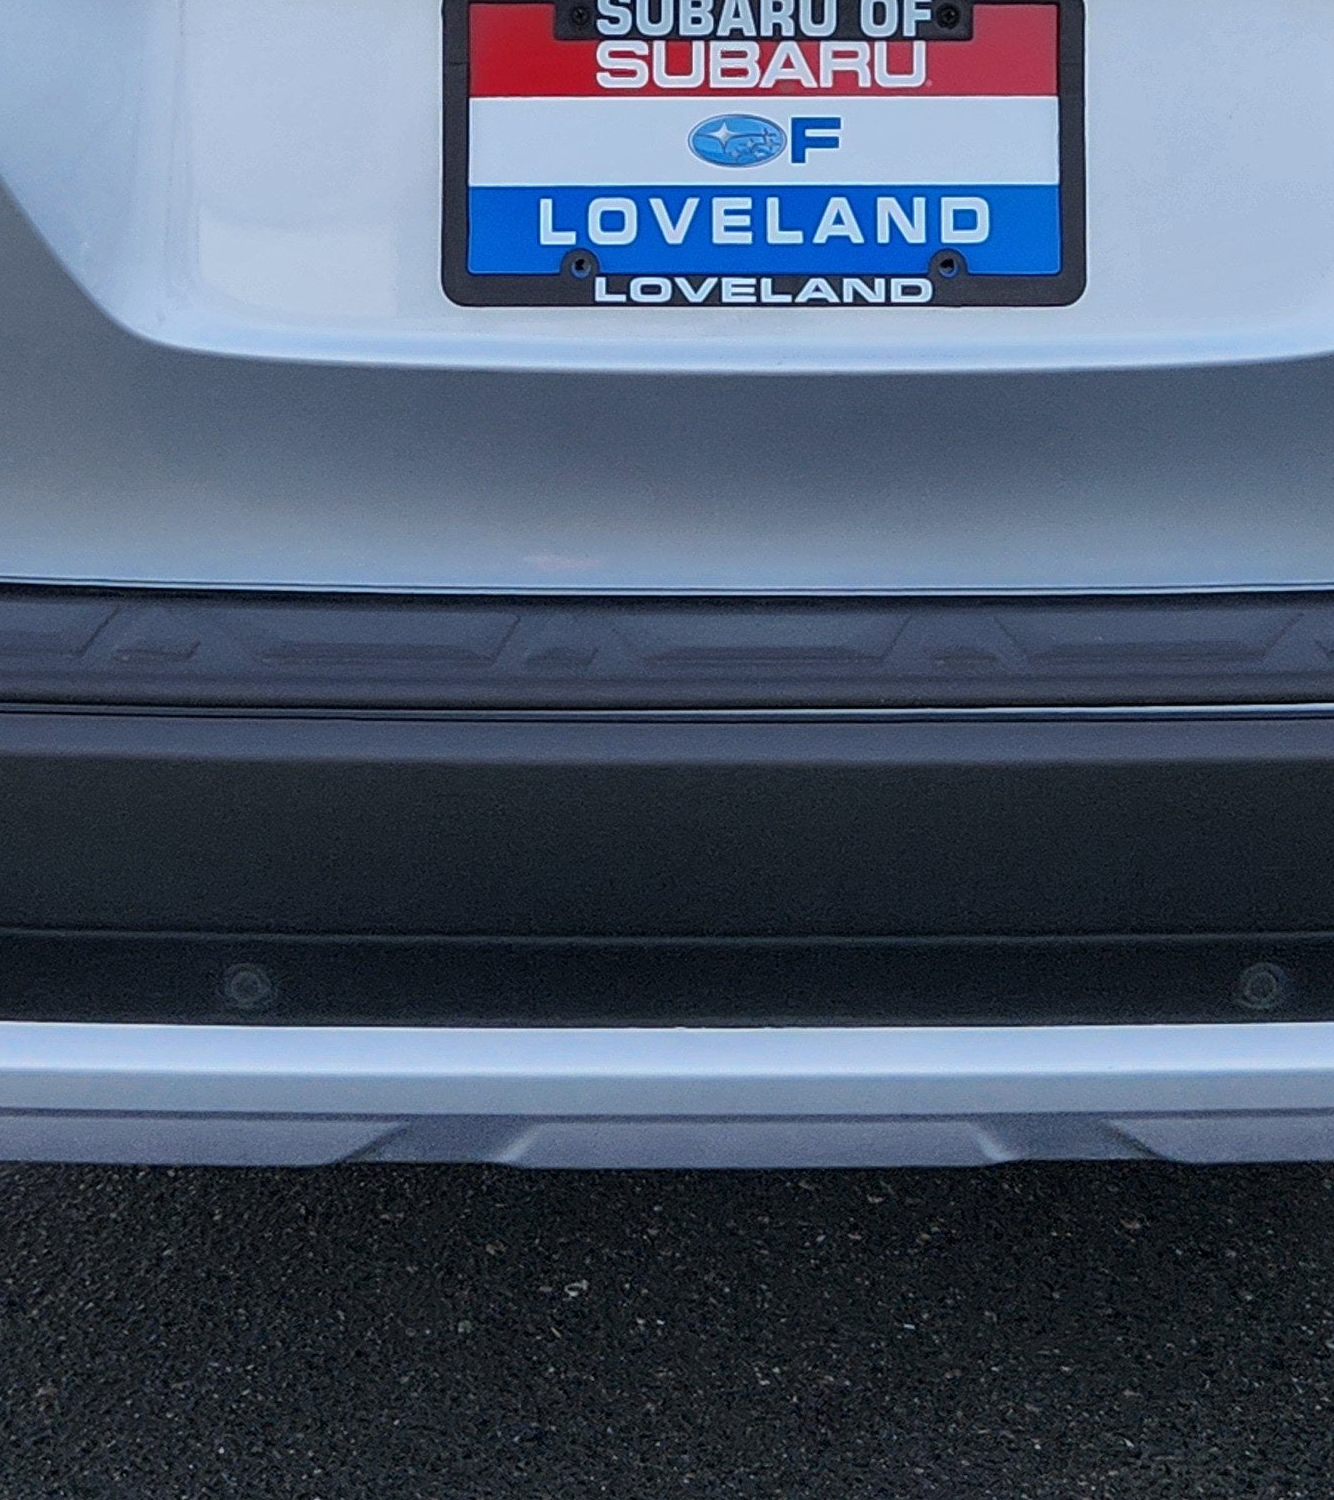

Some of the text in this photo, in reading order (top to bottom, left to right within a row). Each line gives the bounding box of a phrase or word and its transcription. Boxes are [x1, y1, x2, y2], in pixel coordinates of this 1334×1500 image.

[595, 40, 927, 89] SUBARU
[538, 196, 991, 246] LOVELAND
[593, 276, 934, 303] LOVELAND
